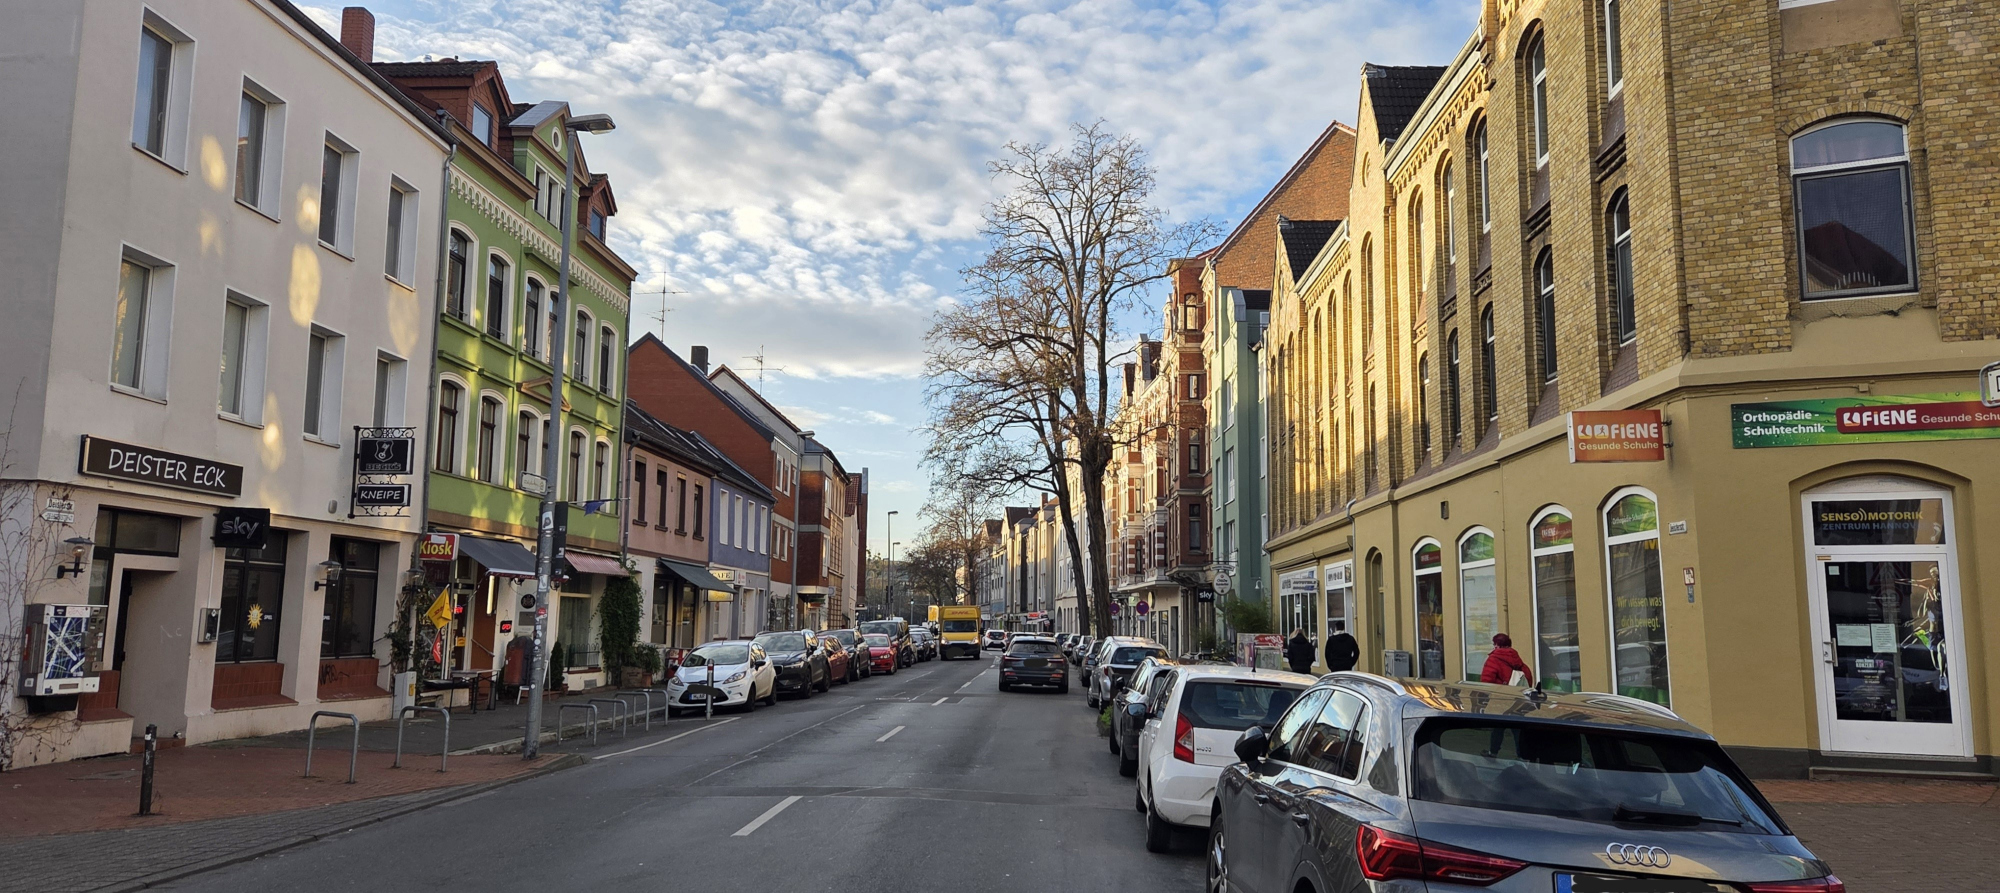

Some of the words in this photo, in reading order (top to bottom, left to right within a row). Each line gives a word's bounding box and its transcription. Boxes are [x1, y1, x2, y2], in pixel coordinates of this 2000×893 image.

[1743, 410, 1812, 424] Orthopädie
[1921, 413, 1972, 424] Gesunde
[1743, 423, 1826, 437] Schuhtechnik
[1578, 442, 1621, 451] Gesunde
[1623, 441, 1659, 450] Schuhe
[108, 448, 187, 481] DEISTER
[193, 465, 226, 488] ECK
[360, 490, 401, 500] KNEIPE
[221, 516, 259, 539] sky
[1822, 522, 1871, 531] ZENTRUM
[420, 540, 453, 556] Kiosk
[1199, 590, 1213, 600] sky
[1616, 596, 1627, 608] Wir
[1629, 595, 1649, 608] wissen
[1650, 596, 1662, 607] was
[1621, 615, 1634, 628] dich
